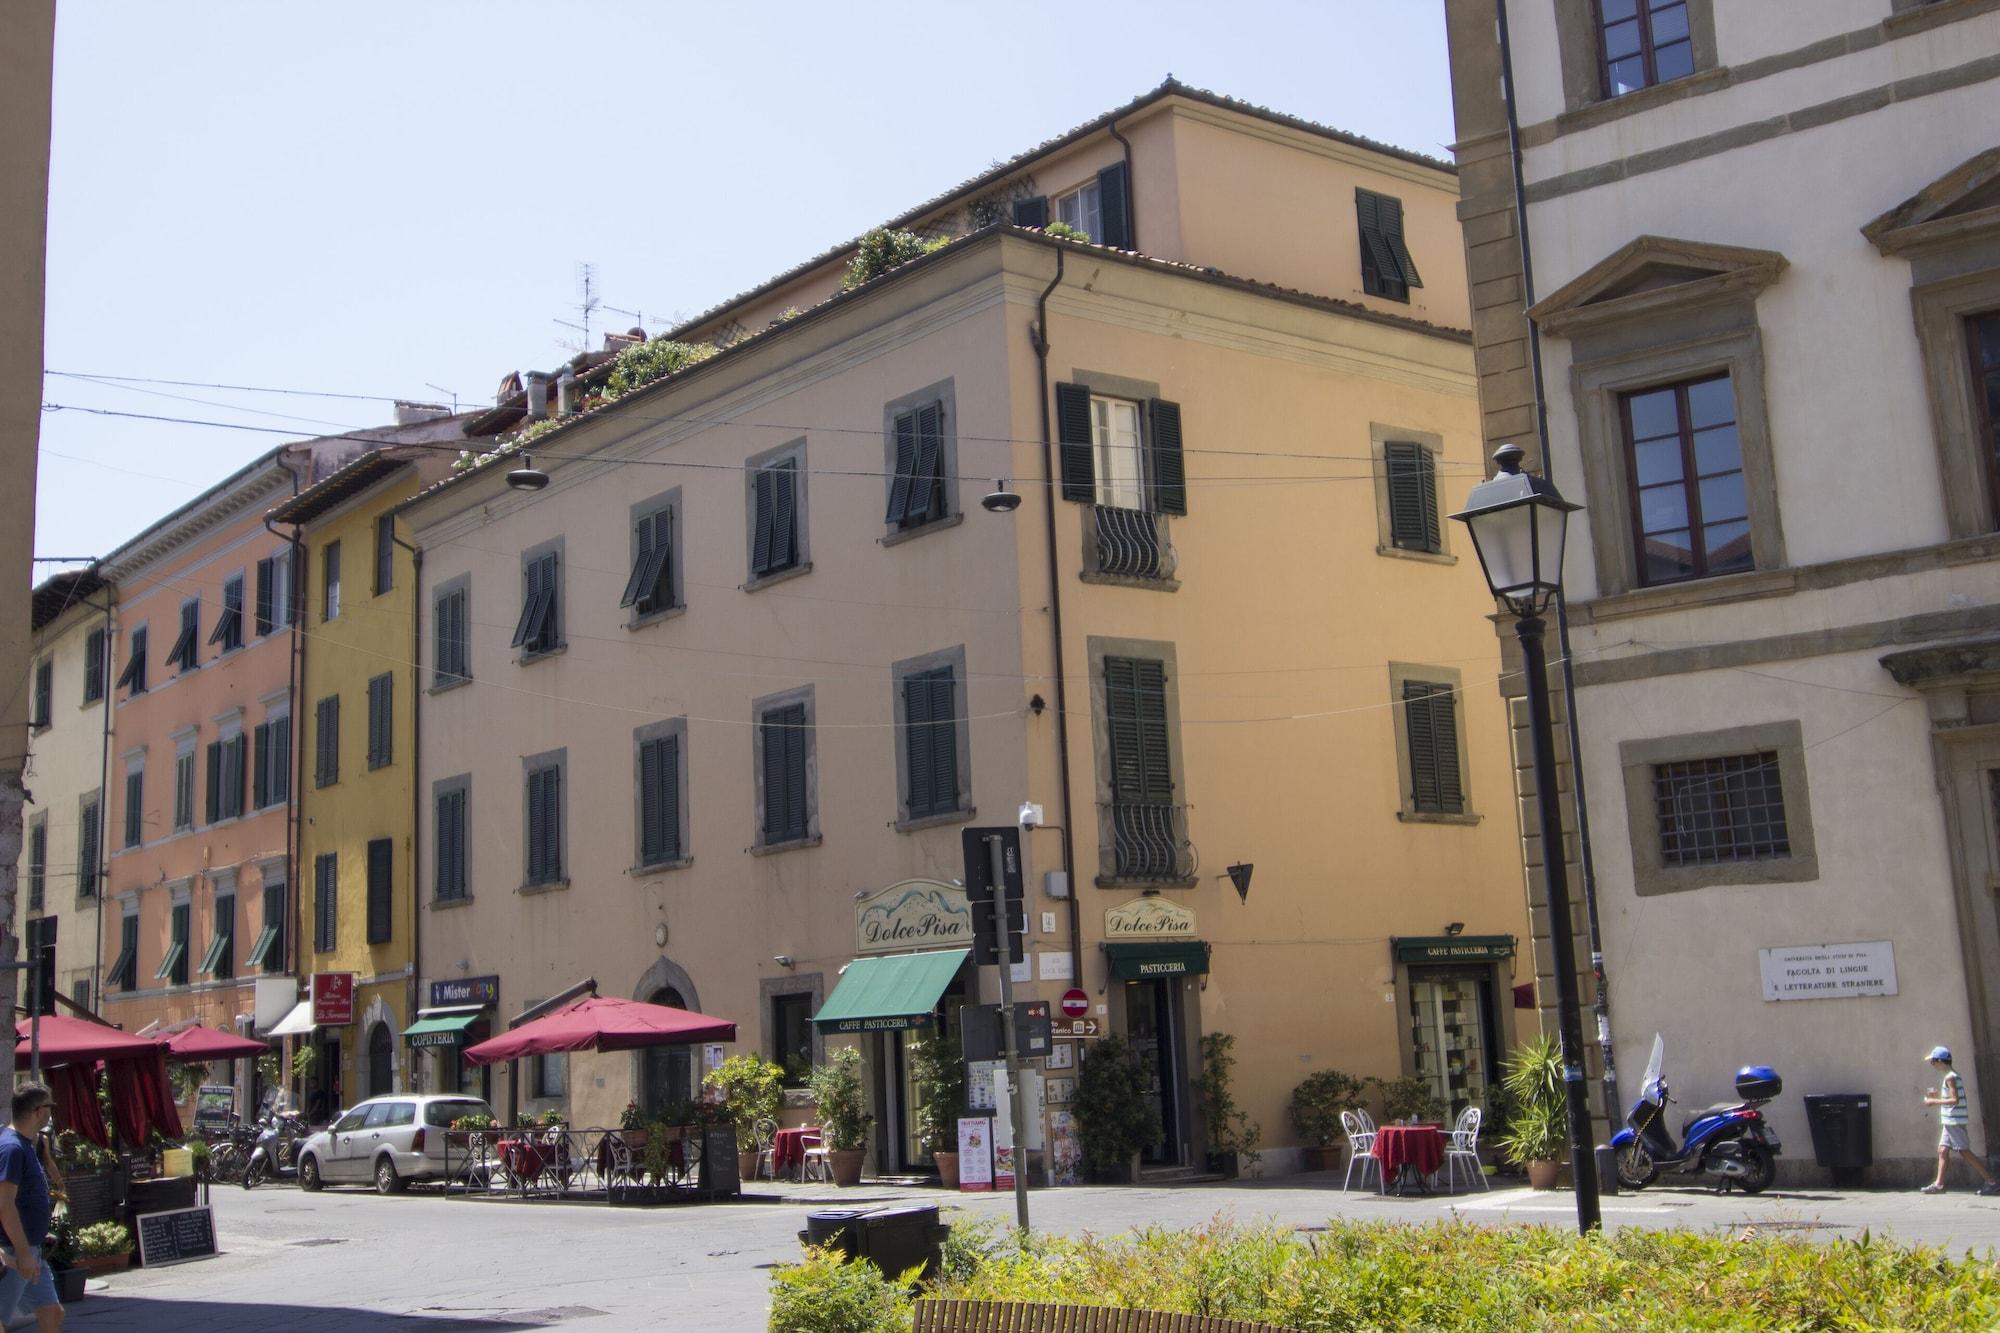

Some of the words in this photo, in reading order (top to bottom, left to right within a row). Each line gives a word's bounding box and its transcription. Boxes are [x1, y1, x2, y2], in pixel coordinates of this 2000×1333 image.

[866, 918, 917, 943] Dolce
[917, 913, 962, 937] Pisa
[1110, 916, 1153, 932] Dolce
[1154, 916, 1191, 932] Pisa
[1140, 962, 1186, 974] PASTICCERIA
[1826, 967, 1836, 975] DI
[1840, 965, 1869, 974] LINGUE
[443, 983, 470, 1000] Mister
[1784, 981, 1838, 991] LETTERATURE
[1841, 979, 1885, 989] STRANIERE
[864, 1018, 908, 1029] PASTICCERIA
[411, 1032, 455, 1046] COPISTERIA
